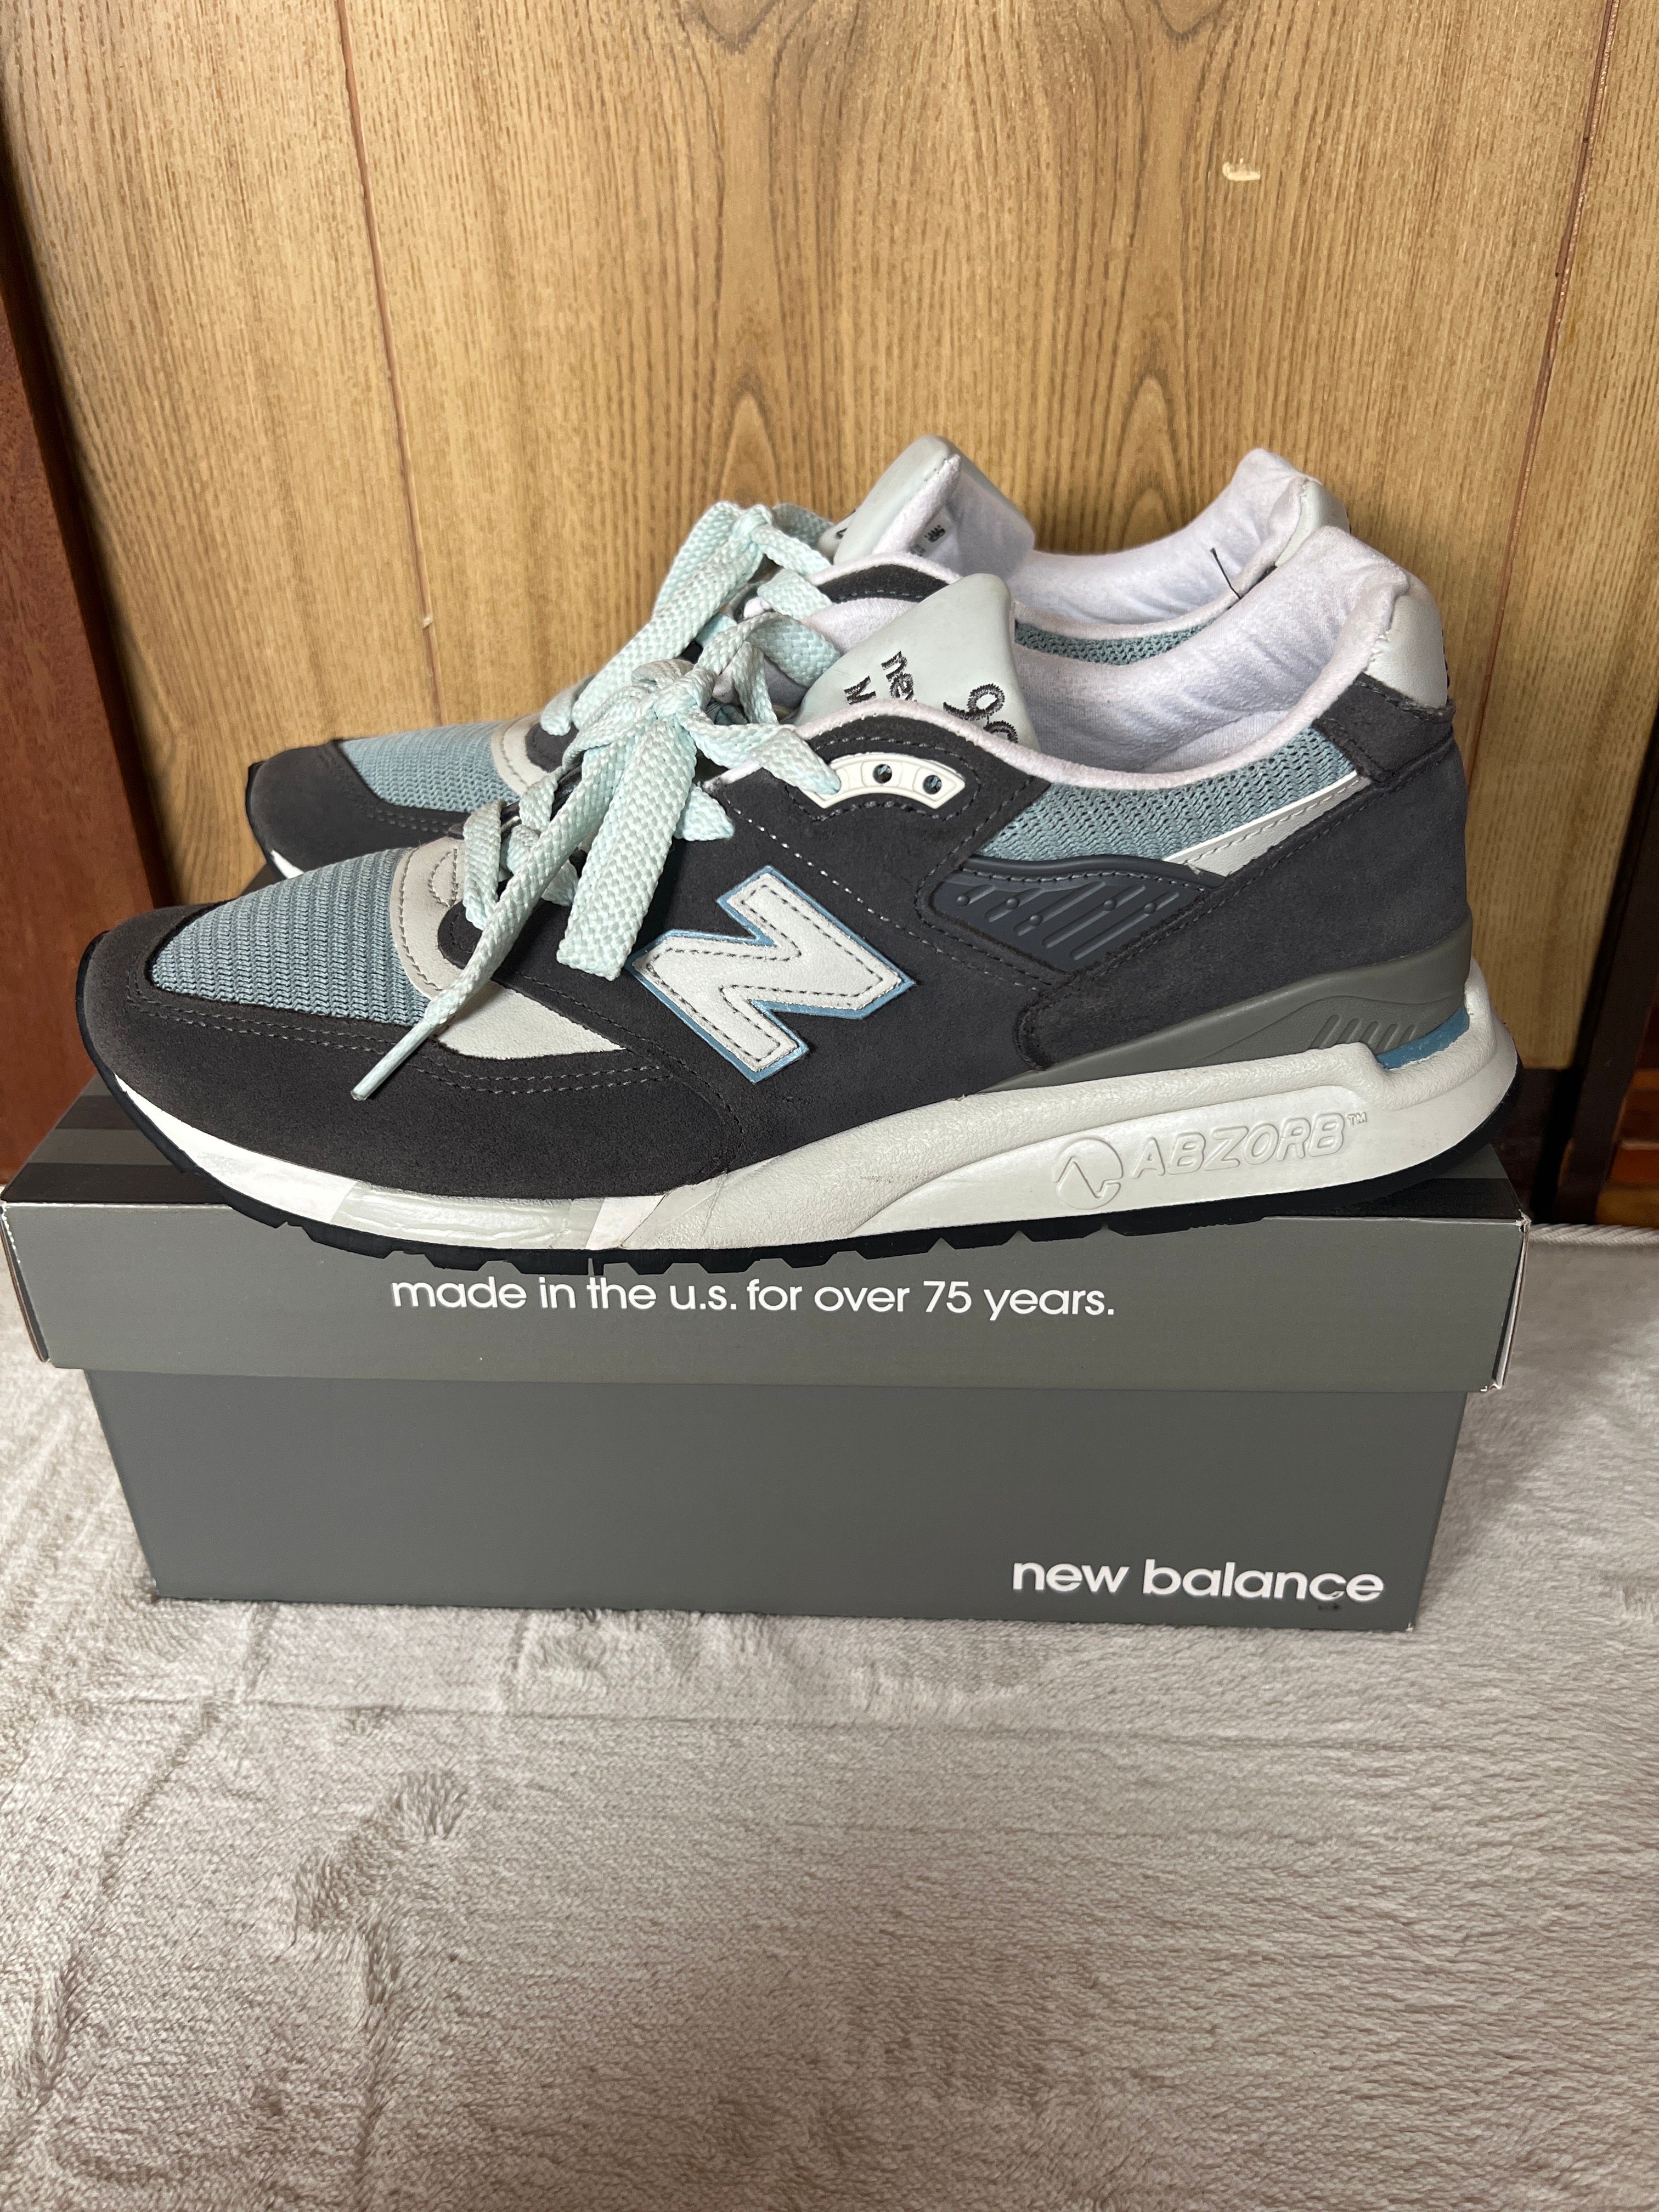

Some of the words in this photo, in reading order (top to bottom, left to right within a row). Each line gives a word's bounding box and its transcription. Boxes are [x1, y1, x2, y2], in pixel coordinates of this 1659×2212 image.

[881, 651, 917, 703] ne
[624, 865, 915, 1084] N
[391, 1276, 527, 1309] made
[539, 1276, 576, 1309] in
[586, 1277, 657, 1310] the
[669, 1285, 737, 1311] u.s.
[746, 1278, 803, 1311] for
[814, 1286, 910, 1312] over
[923, 1280, 972, 1313] 75
[983, 1289, 1114, 1321] years.
[1013, 1562, 1130, 1593] new
[1143, 1559, 1384, 1601] balance
